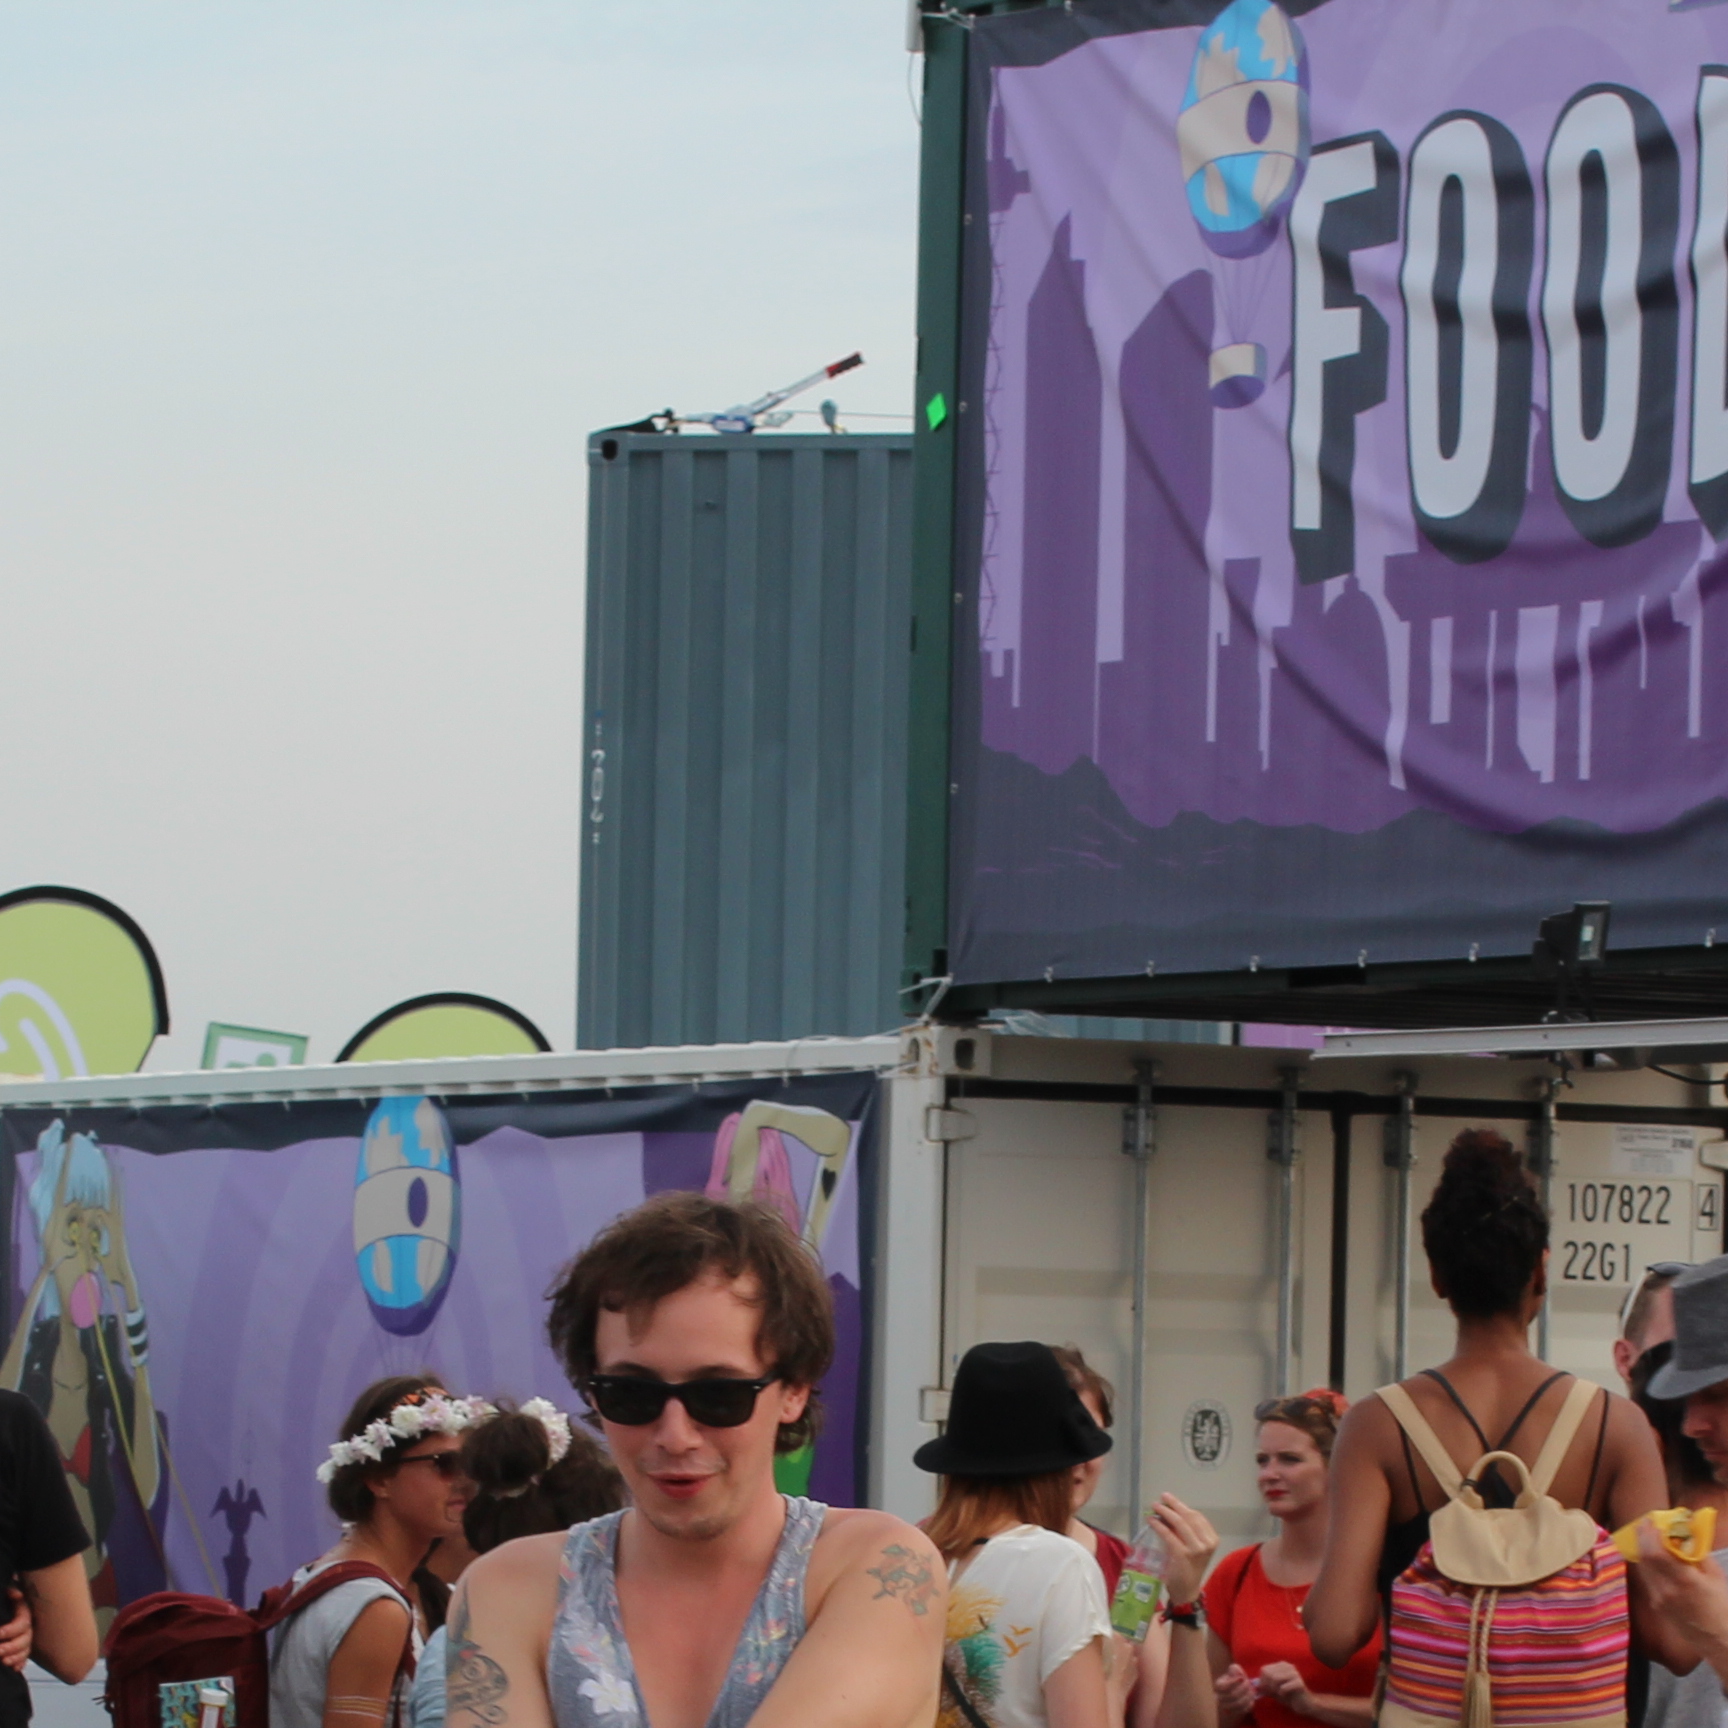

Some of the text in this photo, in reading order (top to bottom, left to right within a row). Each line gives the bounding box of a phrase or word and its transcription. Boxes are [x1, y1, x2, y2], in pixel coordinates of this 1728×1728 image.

[1568, 1183, 1718, 1227] 107822 4
[1563, 1241, 1631, 1282] 22G1
